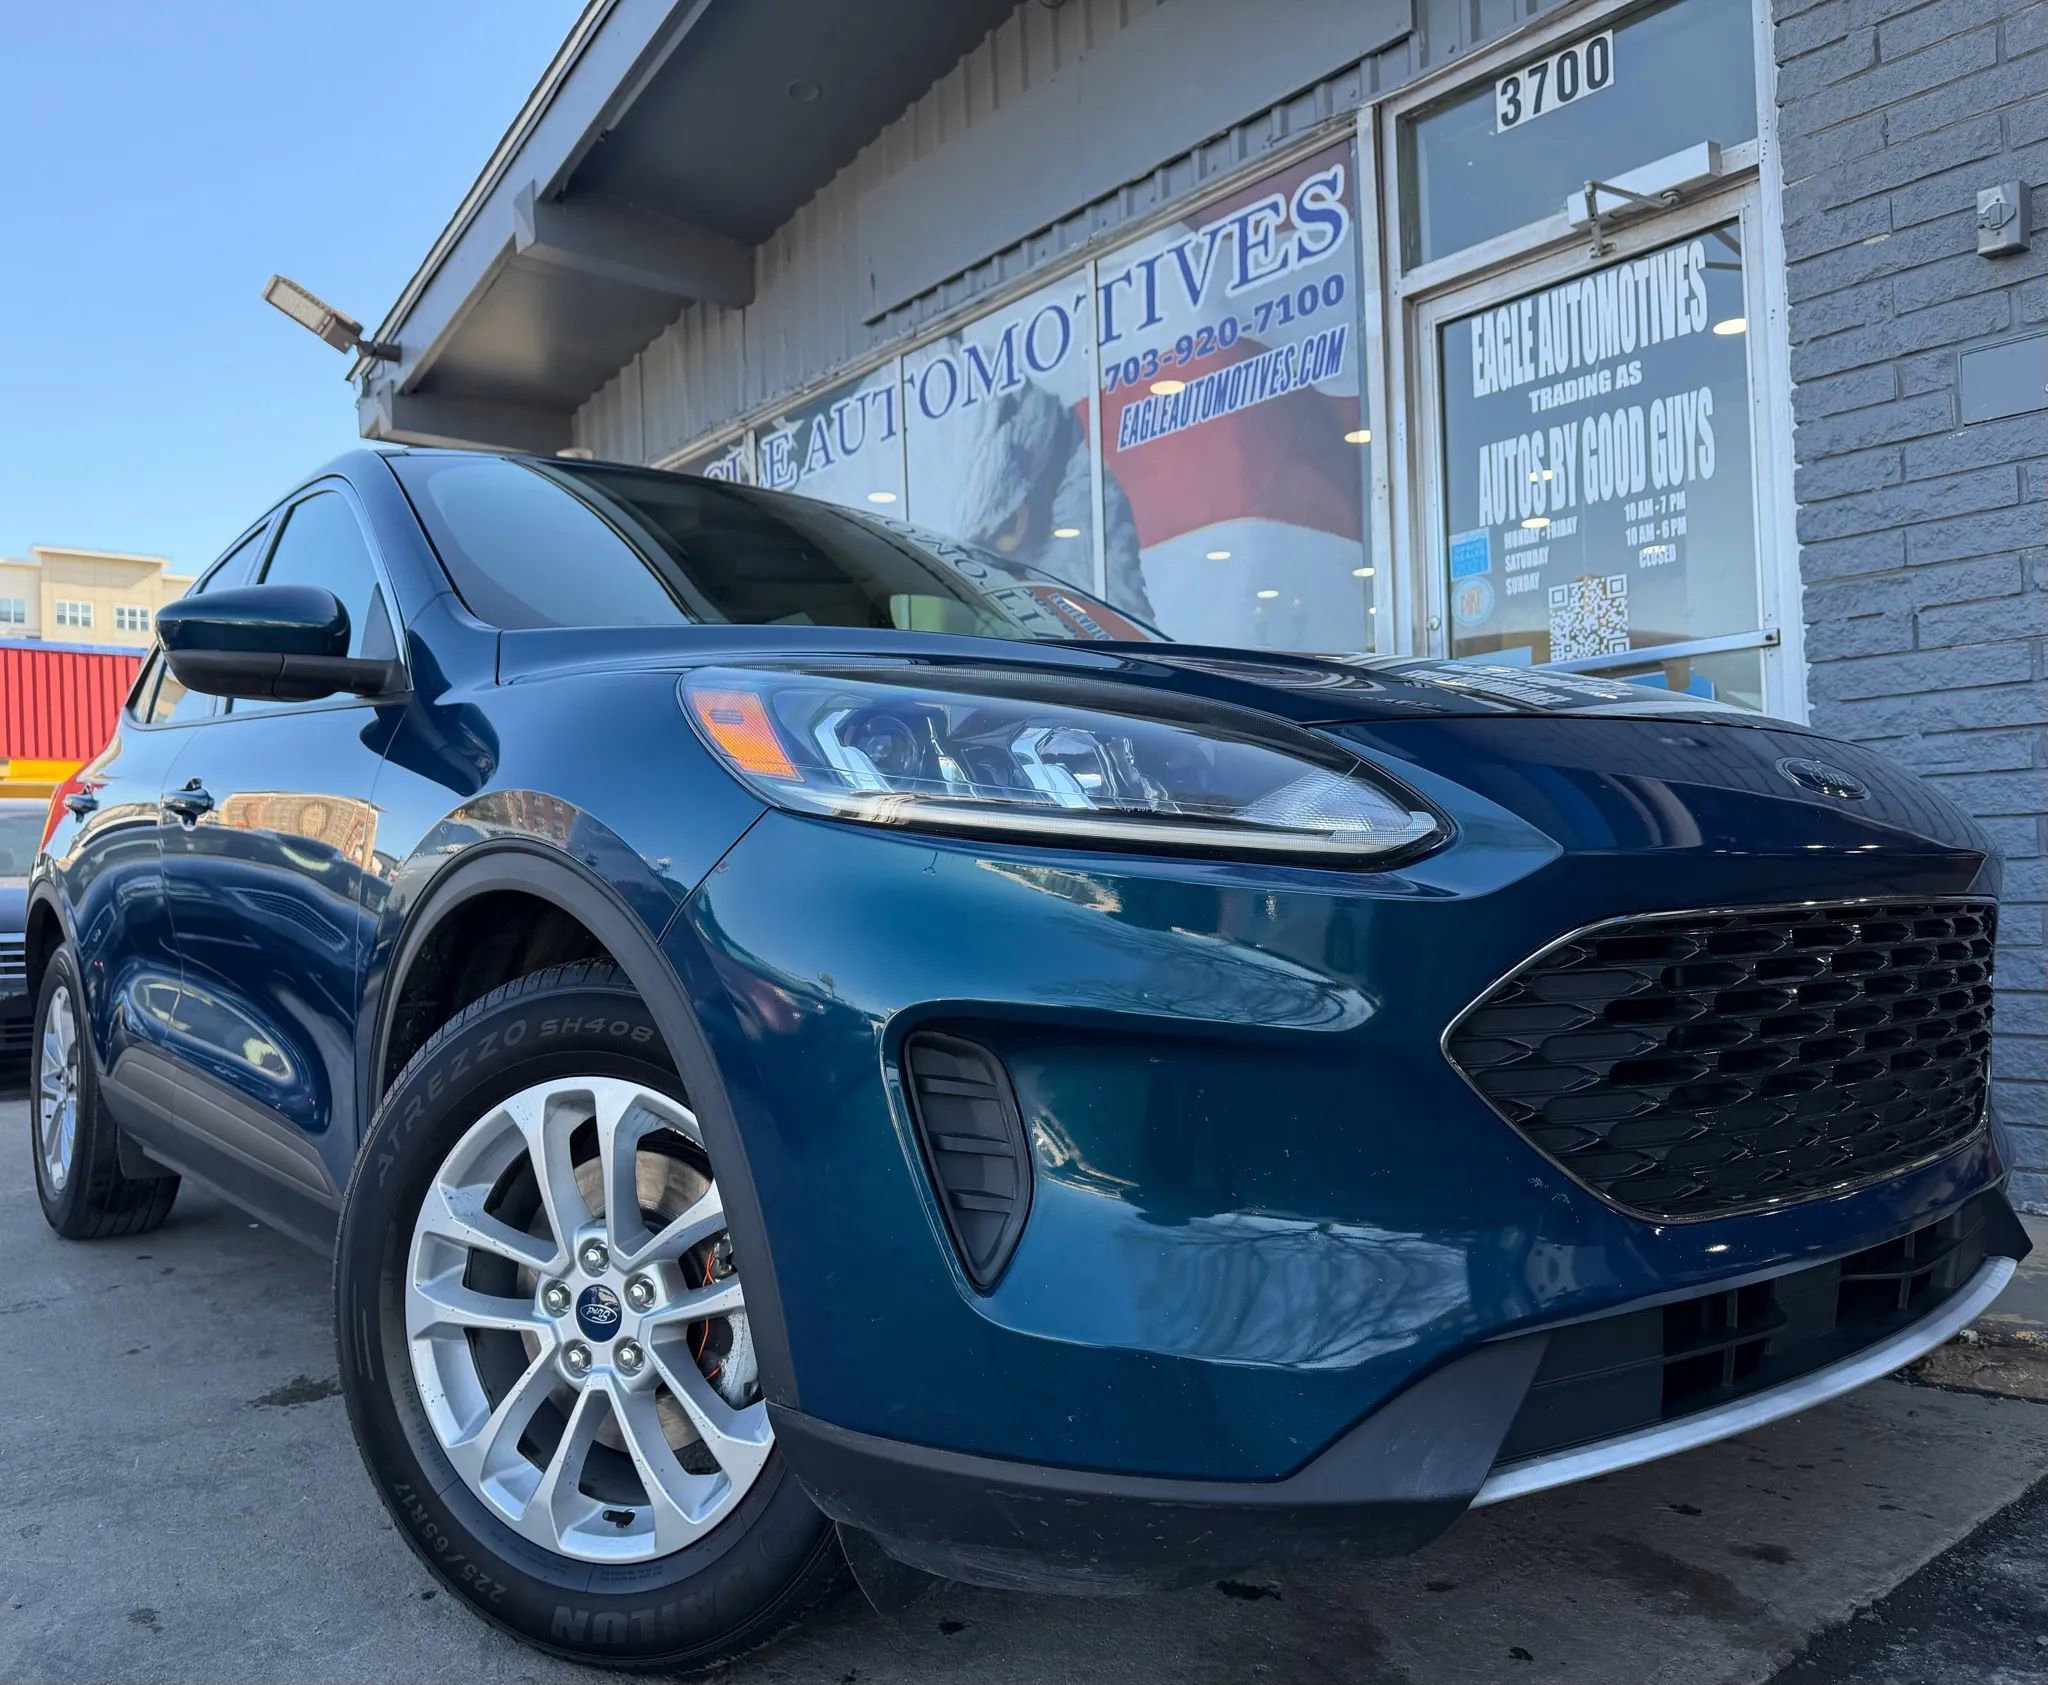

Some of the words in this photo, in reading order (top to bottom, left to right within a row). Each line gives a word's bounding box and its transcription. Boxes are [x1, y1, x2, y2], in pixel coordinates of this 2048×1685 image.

[1500, 36, 1609, 127] 3700
[802, 163, 1350, 478] AUTOMOTIVES
[1104, 273, 1345, 393] 703-920-7100
[1471, 299, 1536, 399] EAGLE
[1538, 240, 1708, 378] AUTOMOTIVES
[1117, 322, 1349, 452] EAGLEAUTOMOTIVES.COM
[1528, 369, 1612, 413] TRADING
[1616, 360, 1643, 388] AS
[1479, 430, 1546, 527] AUTOS
[1549, 421, 1578, 511] BY
[1582, 405, 1647, 505] GOOD
[1650, 386, 1715, 490] GUYS
[1503, 527, 1540, 550] MONDAY
[1546, 516, 1578, 540] FRIDAY
[1623, 501, 1637, 522] 10
[1637, 498, 1654, 519] AM
[1660, 495, 1667, 514] 7
[1669, 490, 1687, 512] PM
[1625, 526, 1638, 546] 10
[1639, 522, 1656, 544] AM
[1661, 519, 1670, 539] 6
[1670, 515, 1688, 537] PM
[1504, 546, 1550, 573] SATURDAY
[1505, 571, 1540, 596] SUNDAY
[1639, 543, 1677, 568] CLOSED
[377, 1019, 527, 1190] ATREZZO
[539, 1016, 654, 1043] SH408
[392, 1481, 508, 1604] 225/65R17
